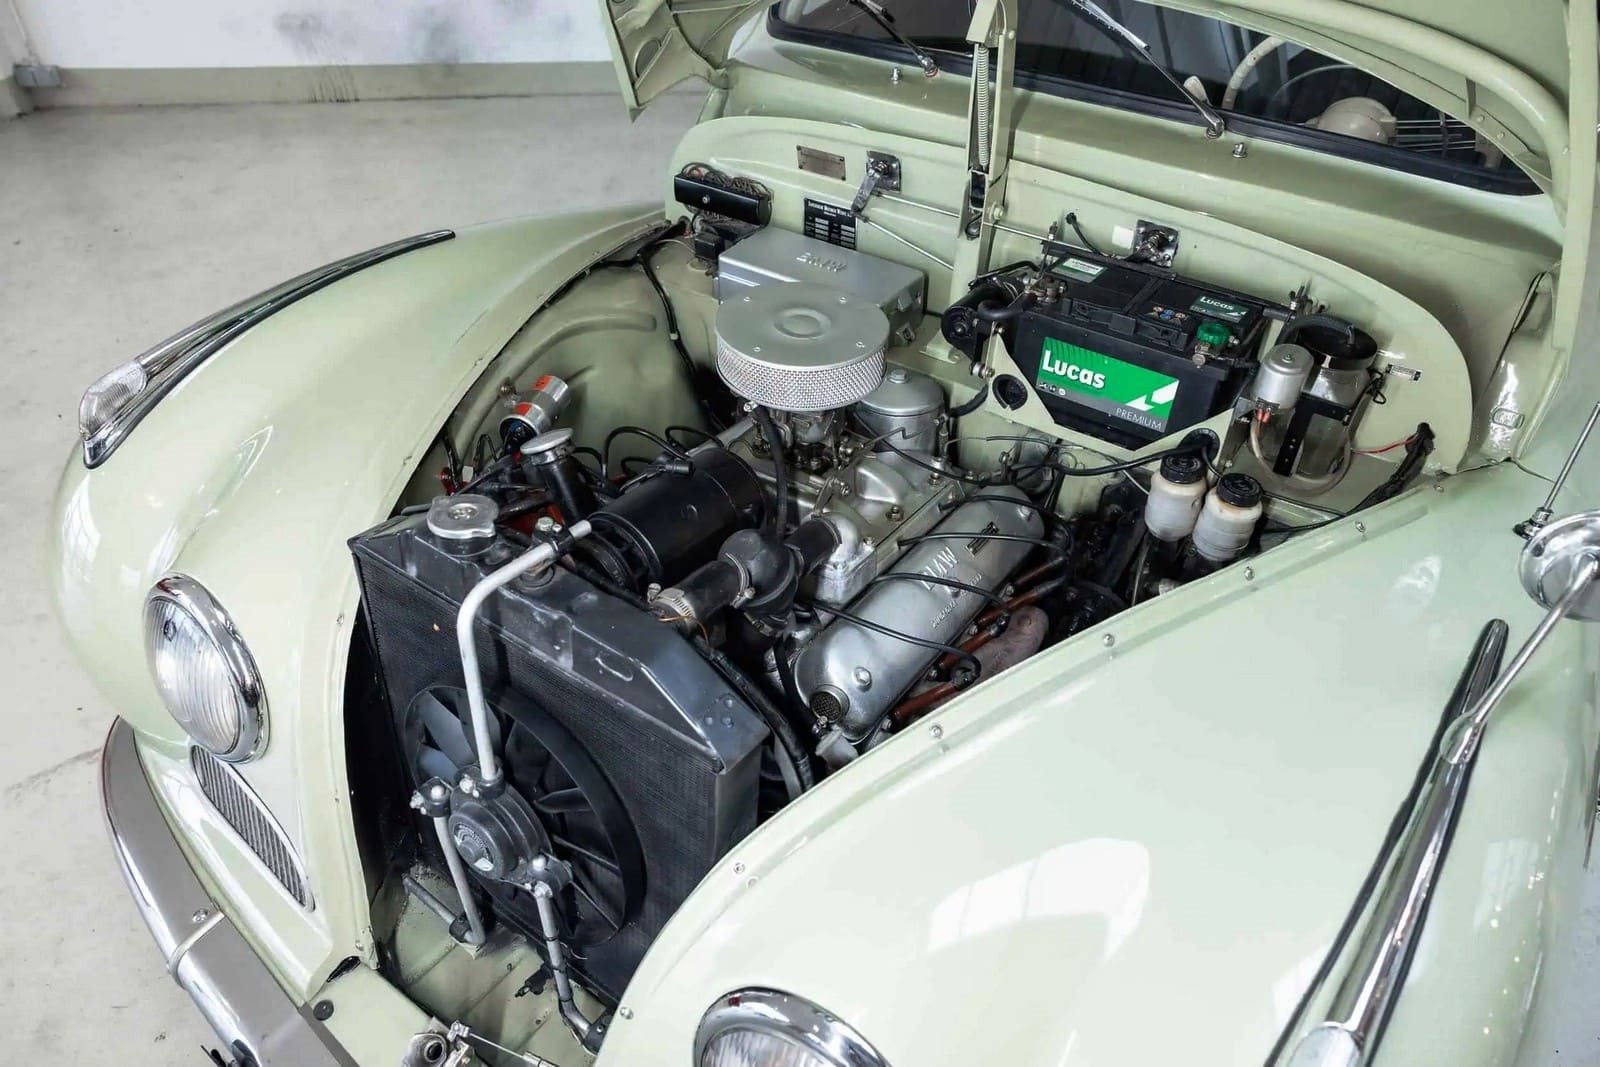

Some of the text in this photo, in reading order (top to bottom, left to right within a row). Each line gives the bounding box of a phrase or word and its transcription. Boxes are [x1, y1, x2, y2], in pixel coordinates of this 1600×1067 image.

[1200, 296, 1234, 310] Lucas
[1042, 350, 1106, 389] Lucas
[1116, 407, 1162, 431] PREMIUM
